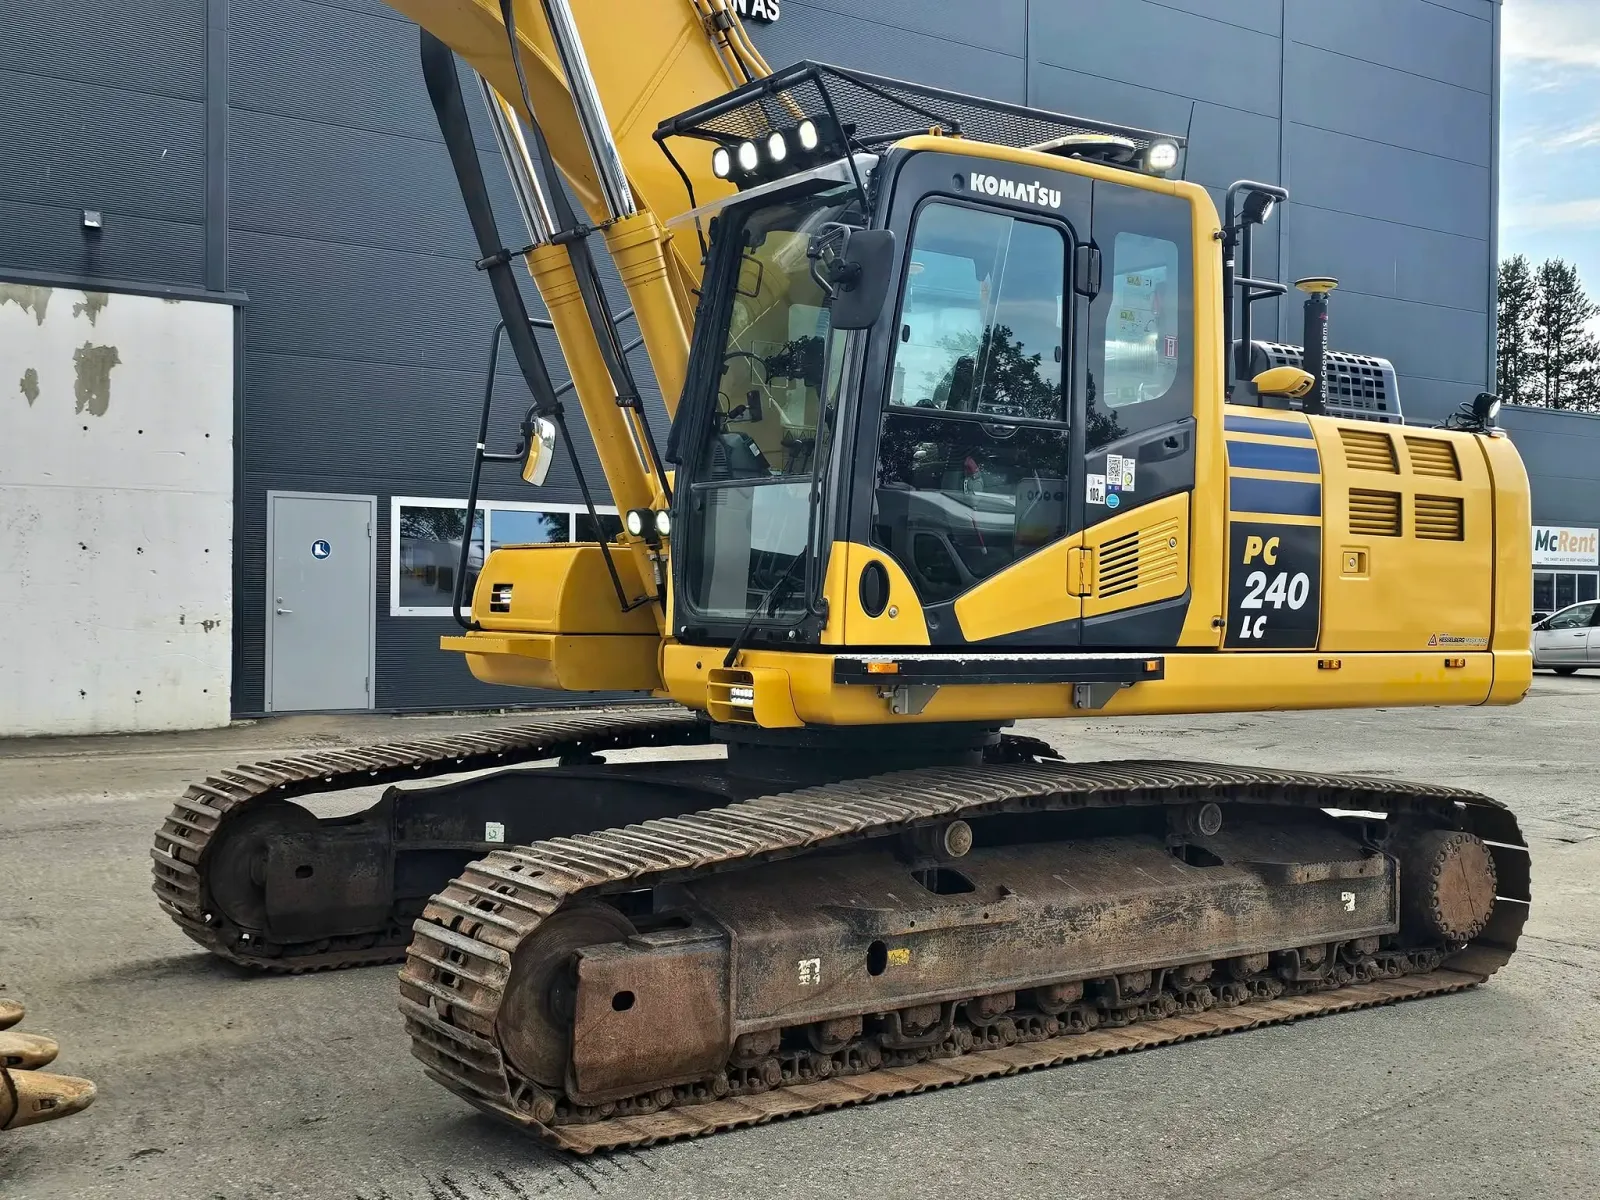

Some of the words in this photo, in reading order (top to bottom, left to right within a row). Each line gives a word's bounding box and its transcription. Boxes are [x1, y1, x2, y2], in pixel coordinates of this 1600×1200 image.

[751, 0, 780, 21] AS
[970, 172, 1061, 209] KOMATSU
[1089, 487, 1100, 502] 103
[1242, 535, 1280, 566] PC
[1534, 529, 1596, 553] McRent
[1240, 570, 1310, 610] 240
[1239, 615, 1268, 639] LC
